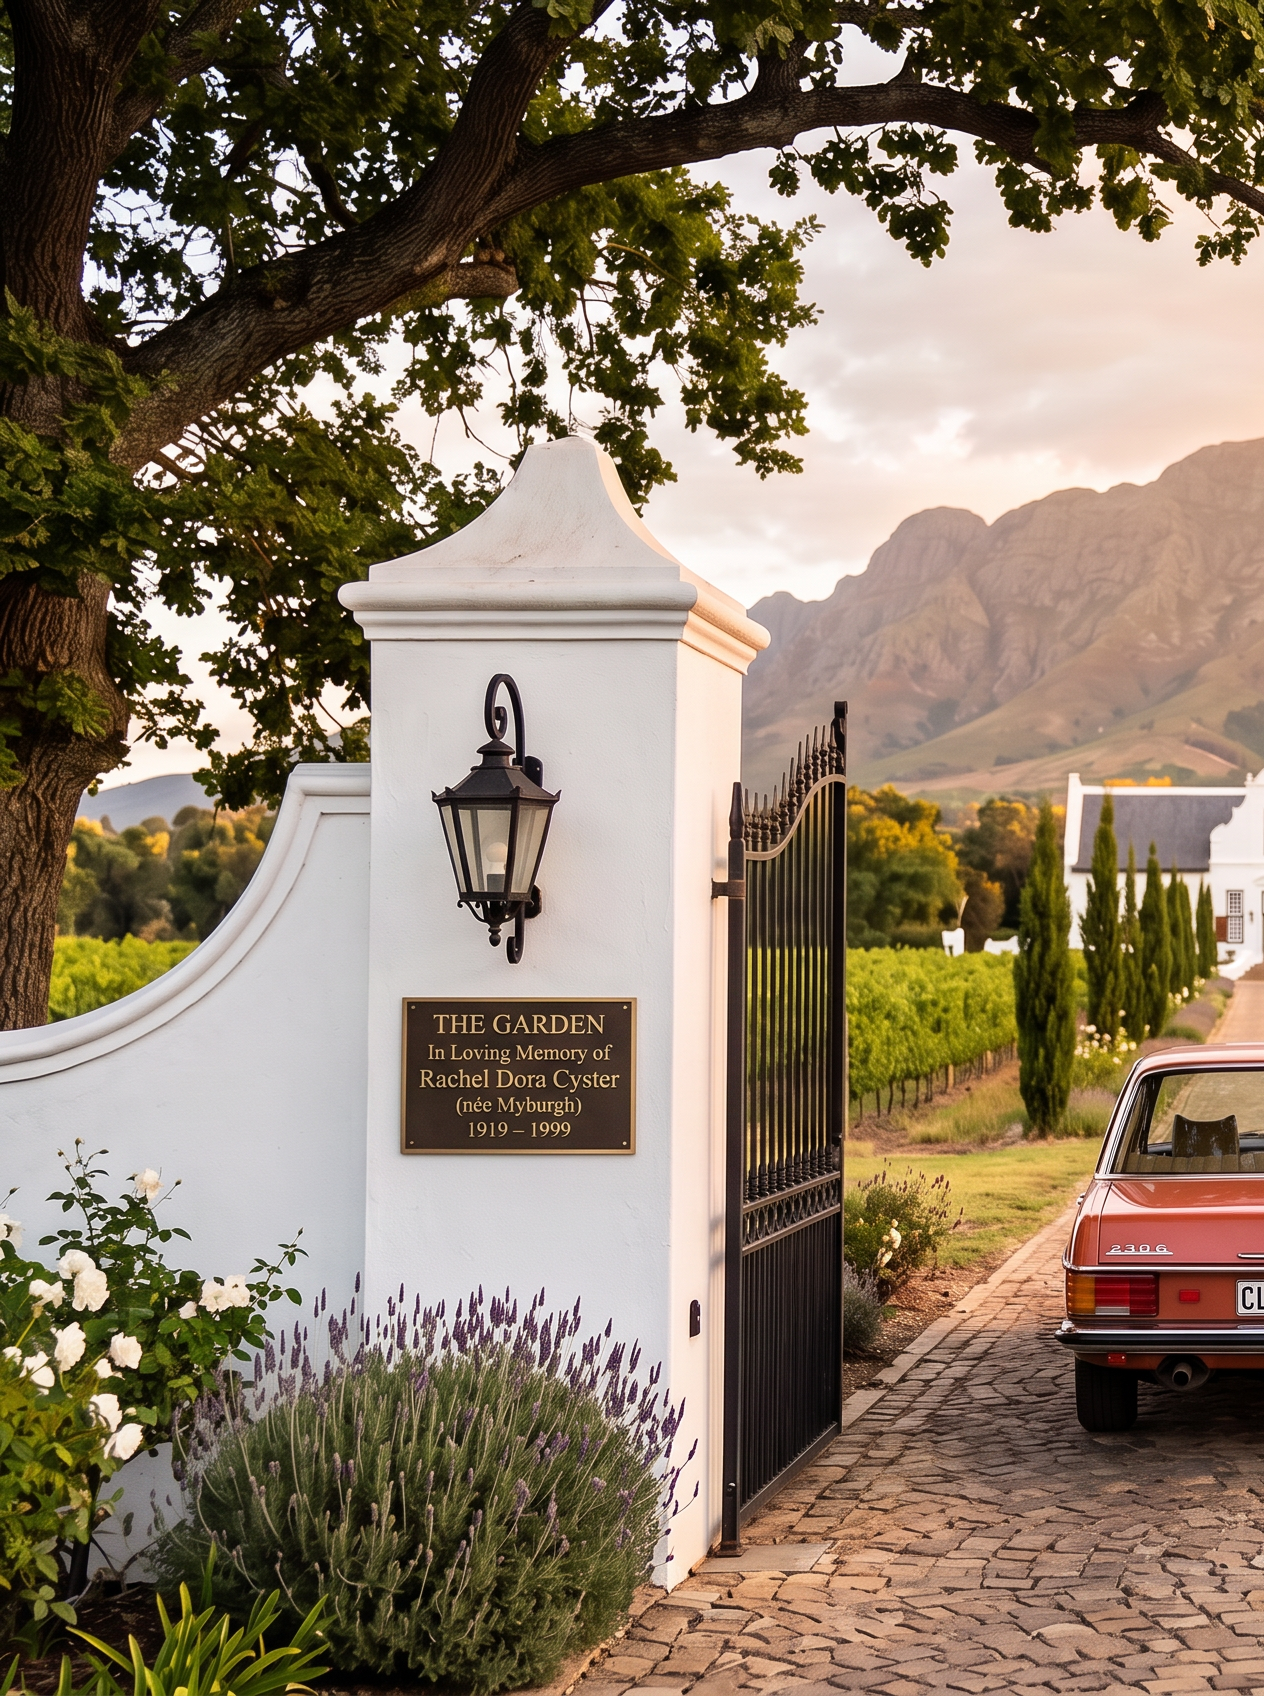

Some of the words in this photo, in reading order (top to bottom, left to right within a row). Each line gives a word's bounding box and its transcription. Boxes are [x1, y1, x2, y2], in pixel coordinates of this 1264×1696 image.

[433, 1014, 486, 1034] THE
[492, 1014, 606, 1035] GARDEN
[427, 1044, 446, 1061] In
[450, 1044, 511, 1065] Loving
[515, 1044, 588, 1065] Memory
[592, 1043, 614, 1061] of
[419, 1068, 490, 1088] Rachel
[495, 1069, 547, 1089] Dora
[552, 1069, 621, 1093] Cyster
[456, 1096, 492, 1117] (née
[497, 1096, 582, 1117] Myburgh)
[468, 1121, 508, 1138] 1919
[531, 1121, 571, 1138] 1999
